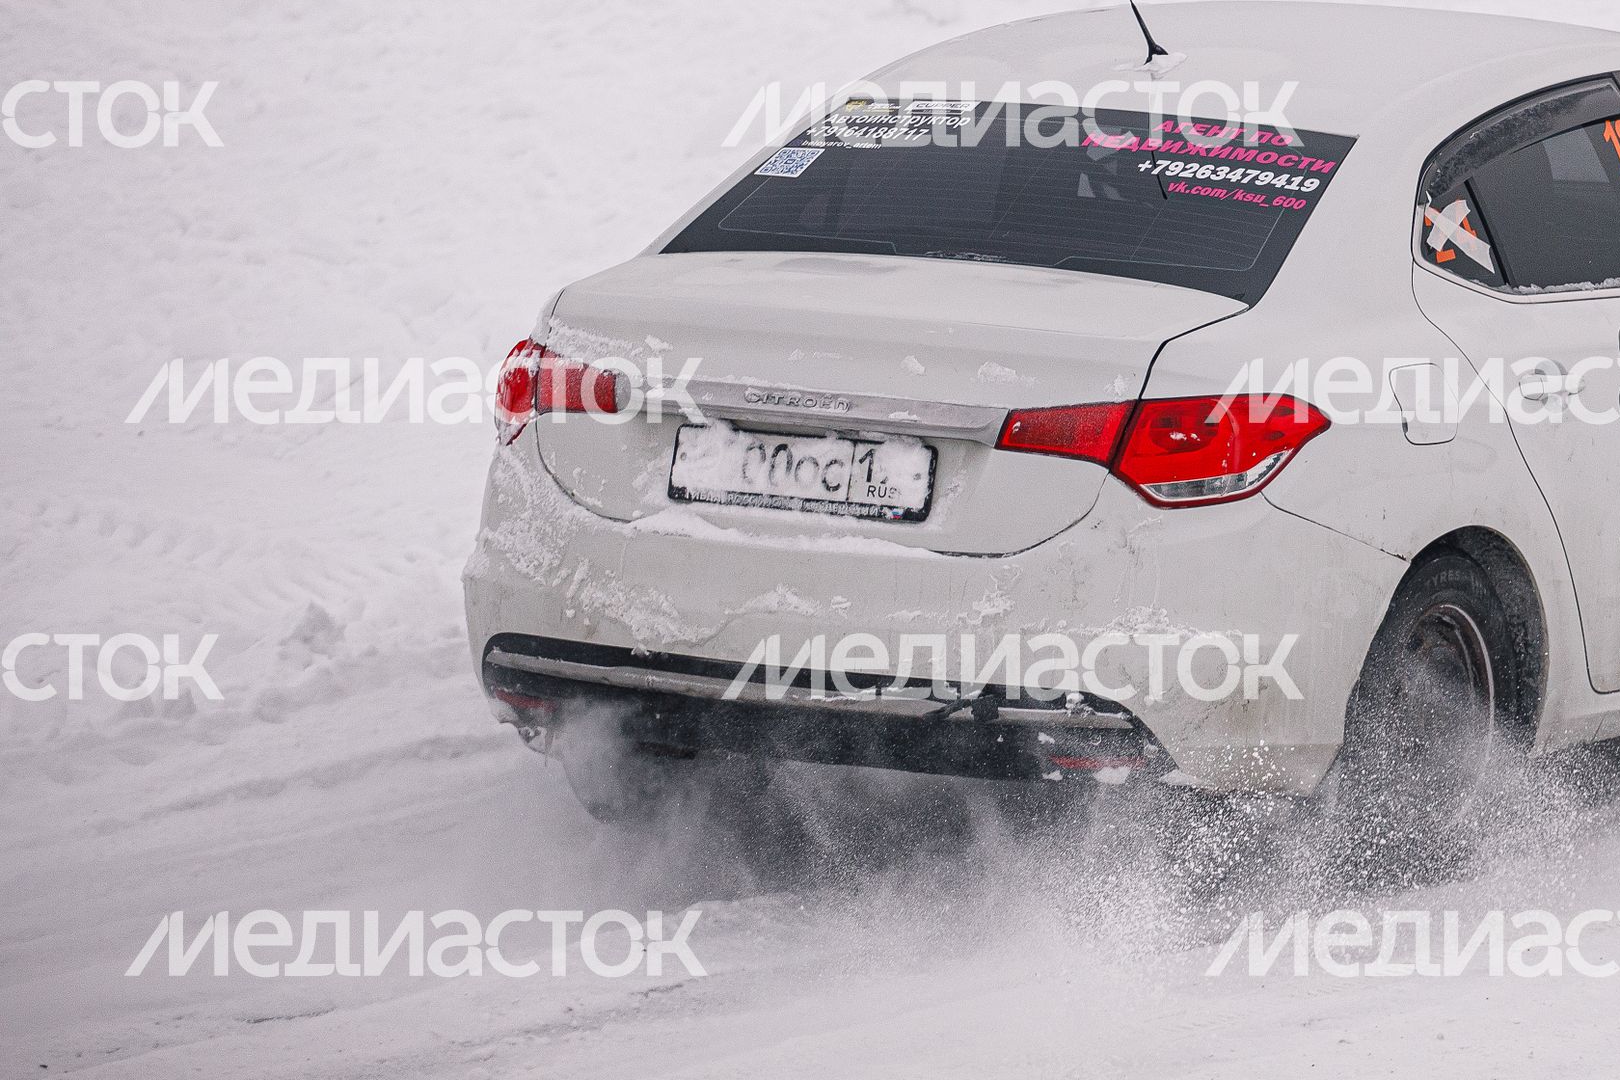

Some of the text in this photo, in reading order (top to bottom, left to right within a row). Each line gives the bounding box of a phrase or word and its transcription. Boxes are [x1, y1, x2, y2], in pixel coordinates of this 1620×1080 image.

[1152, 120, 1294, 147] АГЕНТ ПО
[1081, 133, 1338, 174] НЕДВИЖИМОСТИ
[1137, 159, 1321, 193] +79263479419
[1167, 181, 1308, 210] vk.com/ksu_600
